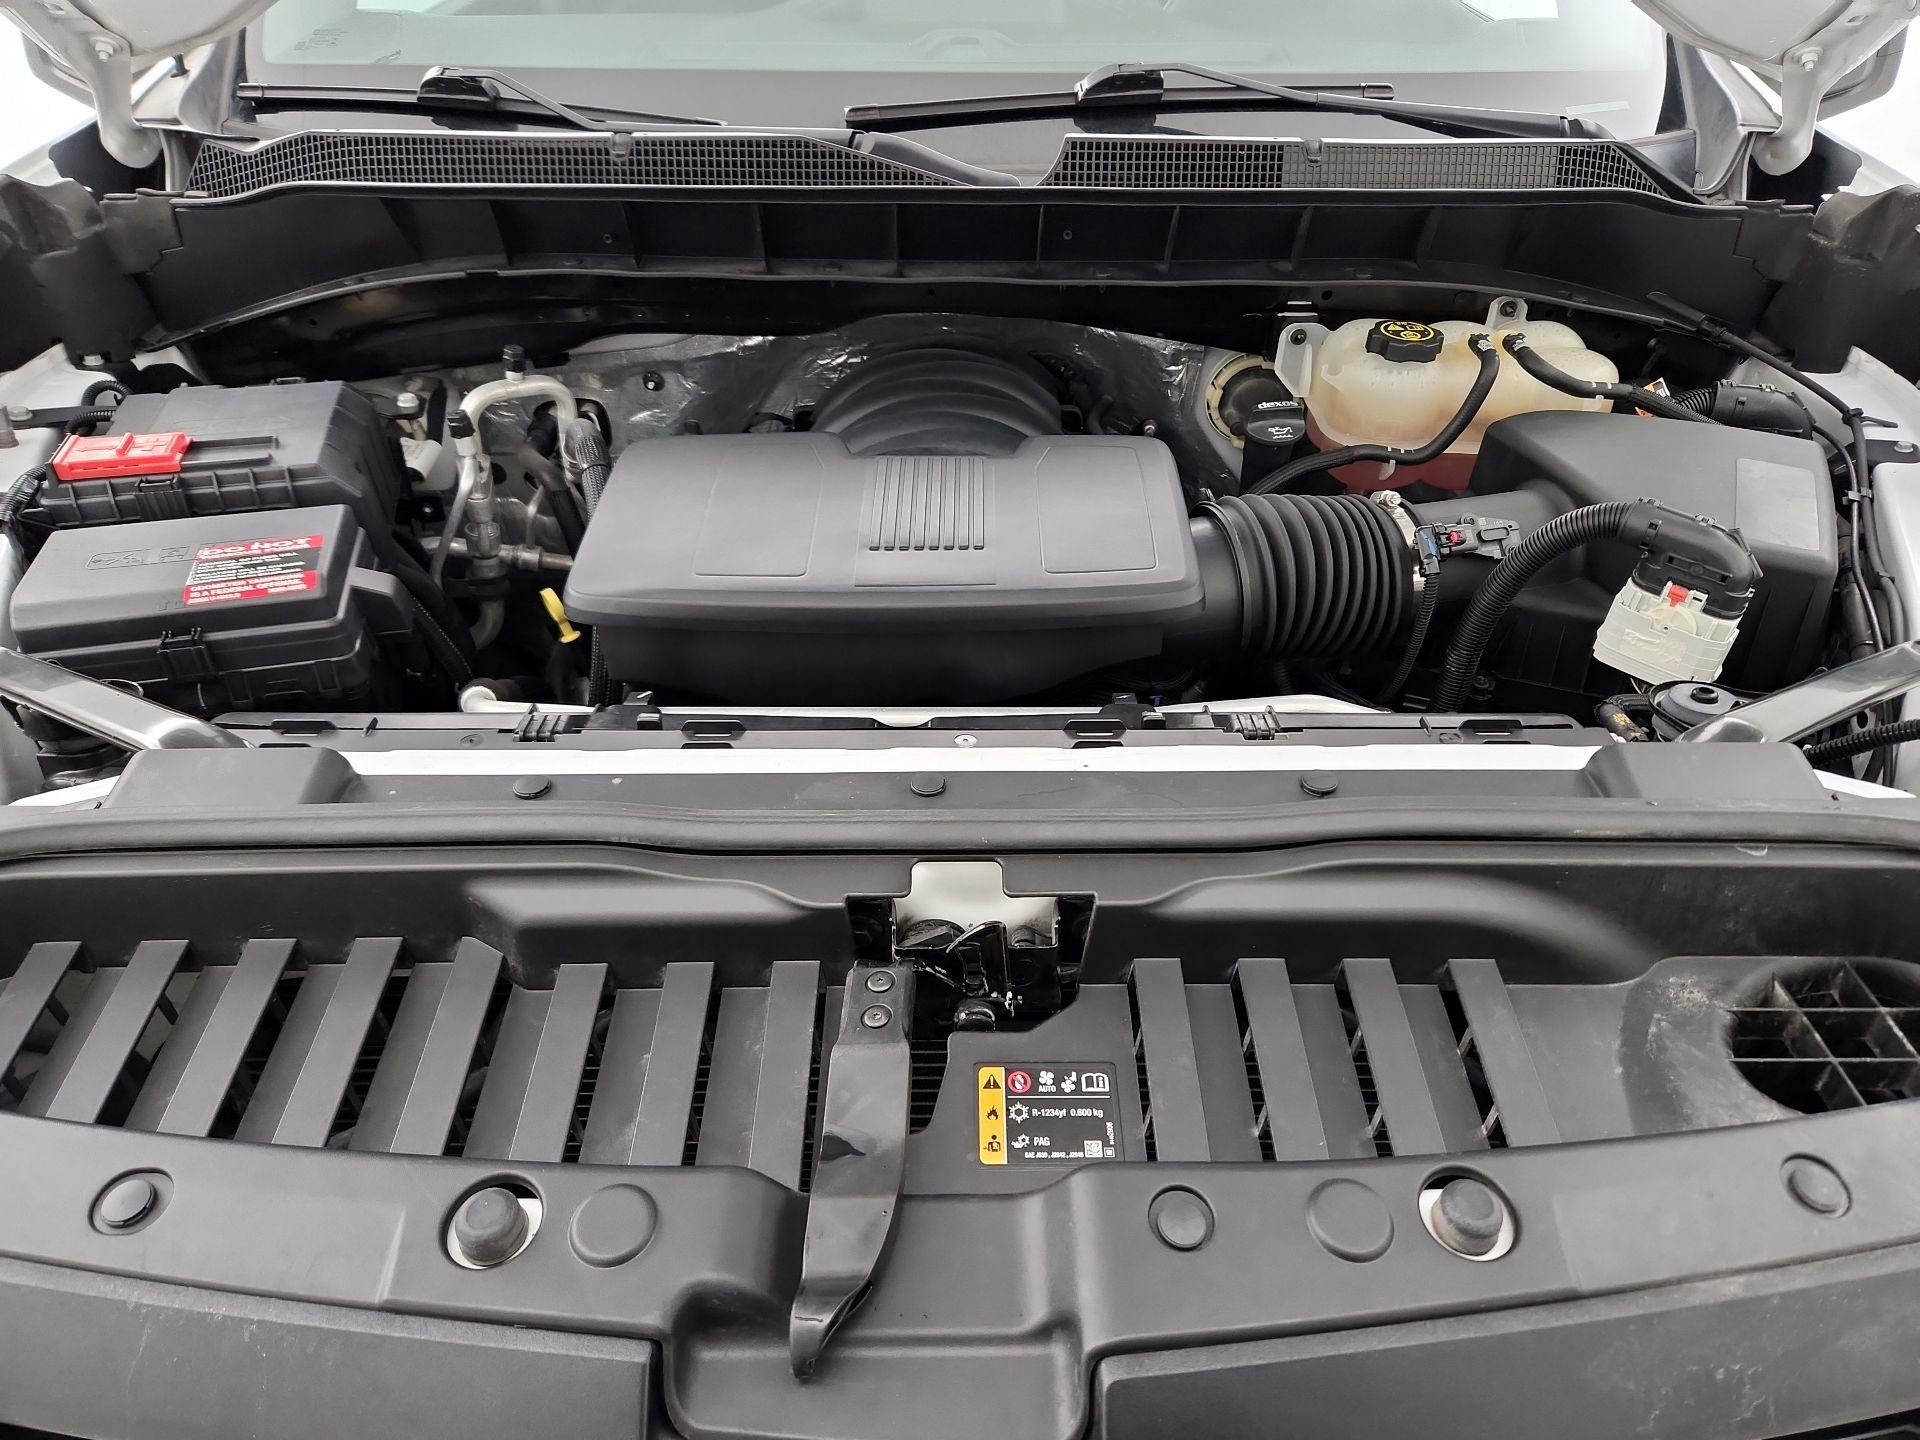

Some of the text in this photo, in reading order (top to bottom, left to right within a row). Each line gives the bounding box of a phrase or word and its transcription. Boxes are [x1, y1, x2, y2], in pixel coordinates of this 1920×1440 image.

[1258, 401, 1298, 409] dexos
[250, 538, 311, 550] NOT
[190, 580, 247, 592] ODOMETER
[211, 585, 256, 595] FEDERAL
[1032, 1108, 1103, 1118] R-1234yf 0.600 kg
[1033, 1137, 1051, 1146] PAG
